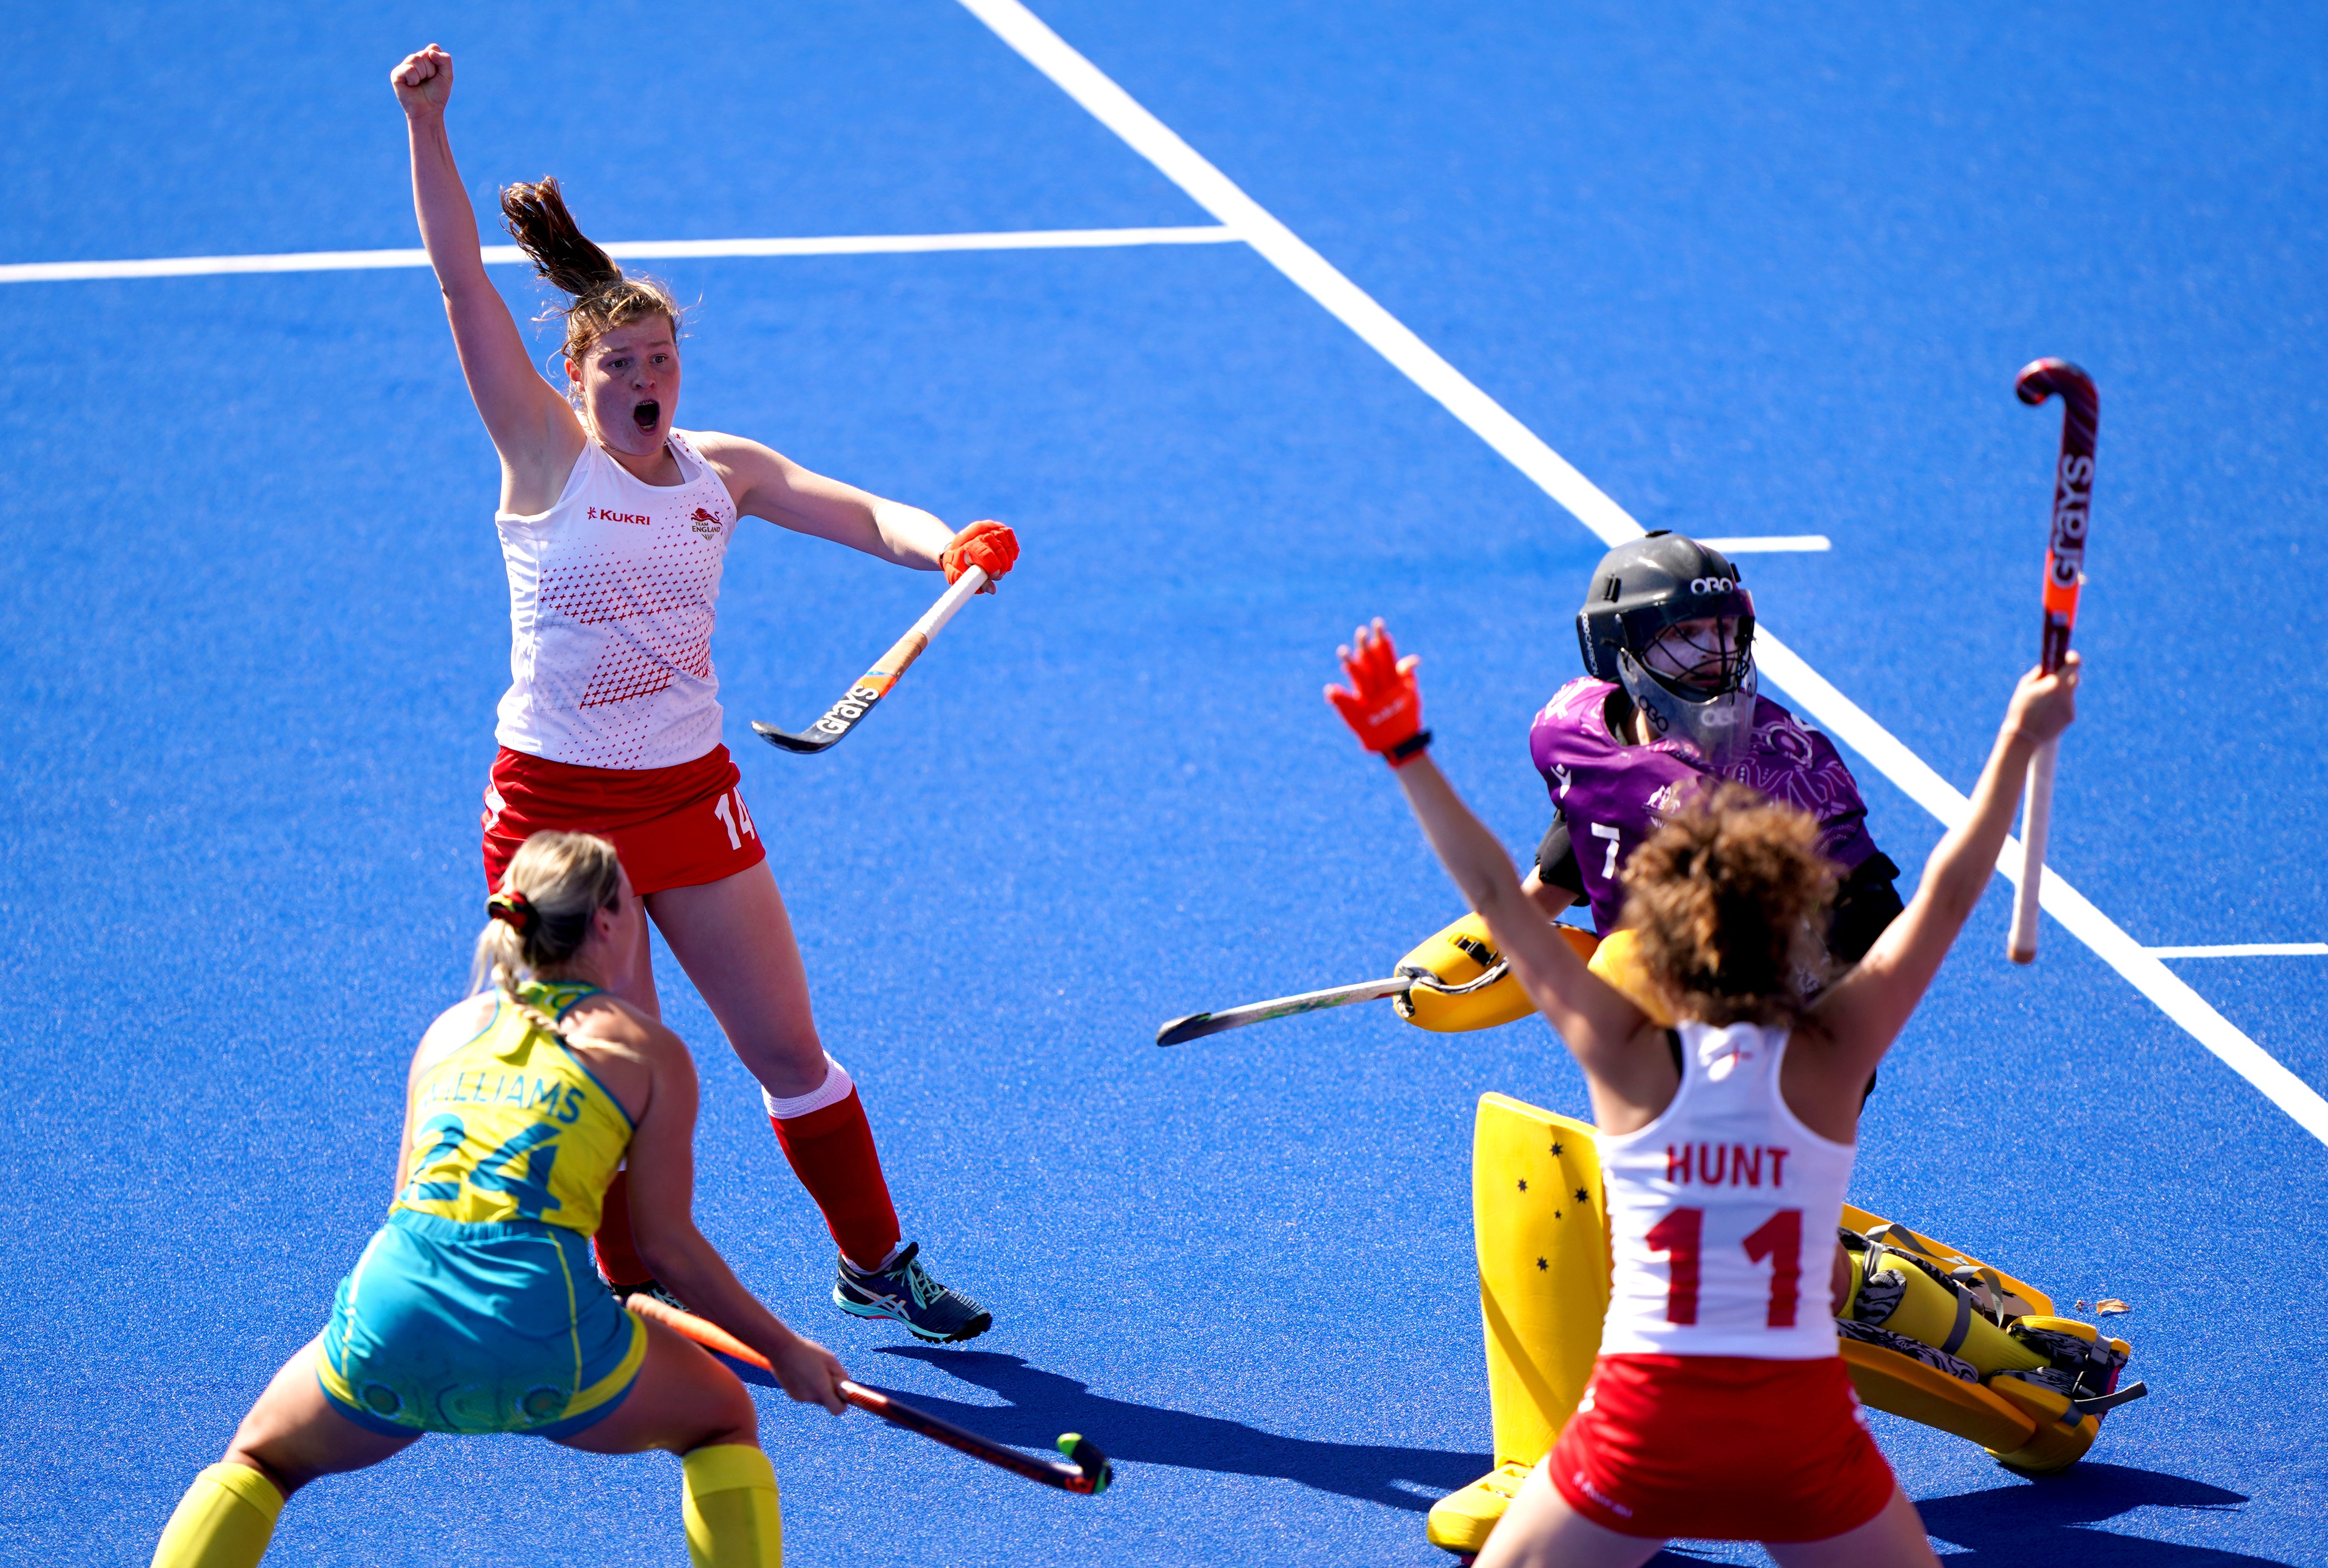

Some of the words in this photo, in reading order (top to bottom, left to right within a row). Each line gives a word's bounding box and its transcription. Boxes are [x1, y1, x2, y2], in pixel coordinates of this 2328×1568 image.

[600, 509, 650, 525] KUKRI
[1691, 577, 1733, 595] OBO
[1639, 695, 1668, 732] OBO
[714, 786, 755, 850] 14
[1591, 822, 1620, 880] 7
[398, 1113, 561, 1221] 24
[1666, 1143, 1790, 1189] HUNT
[1645, 1206, 1803, 1329] 11
